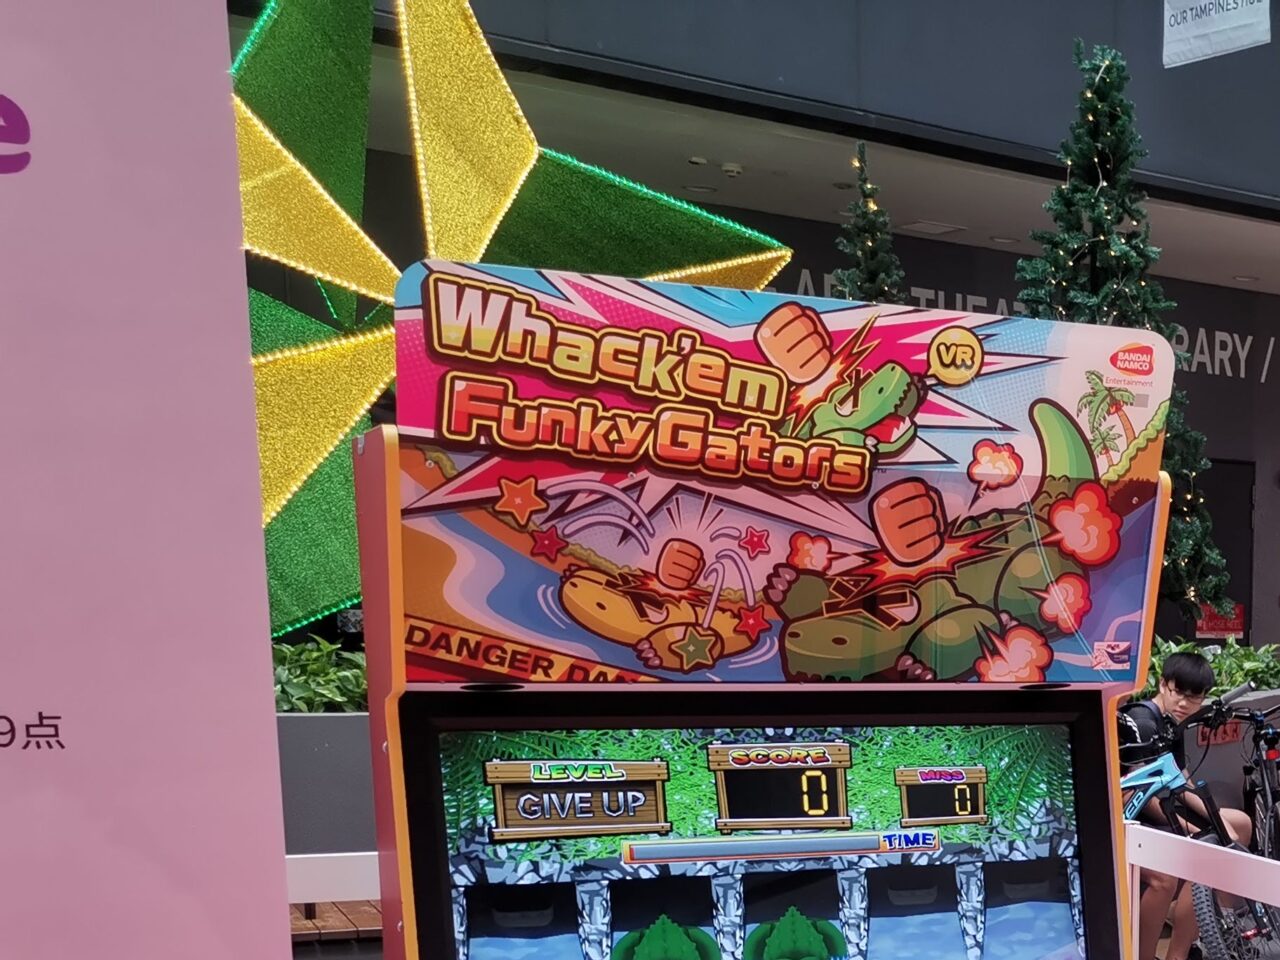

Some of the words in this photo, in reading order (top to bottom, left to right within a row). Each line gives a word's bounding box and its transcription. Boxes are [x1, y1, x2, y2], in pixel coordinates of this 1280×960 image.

[1168, 10, 1188, 27] OUR
[1189, 0, 1239, 21] TAMPINES
[429, 276, 787, 420] Whack'em
[937, 343, 976, 370] VR
[1117, 351, 1151, 362] BANDAI
[1116, 360, 1150, 371] NAMCO
[1105, 376, 1154, 388] Entertainment
[404, 624, 555, 679] DANGER
[730, 747, 831, 767] SCORE
[532, 763, 626, 782] LEVEL
[918, 769, 967, 784] MISS
[801, 770, 829, 816] 0
[954, 785, 972, 815] 0
[517, 792, 594, 820] GIVE
[602, 791, 646, 817] UP
[882, 832, 936, 849] TIME
